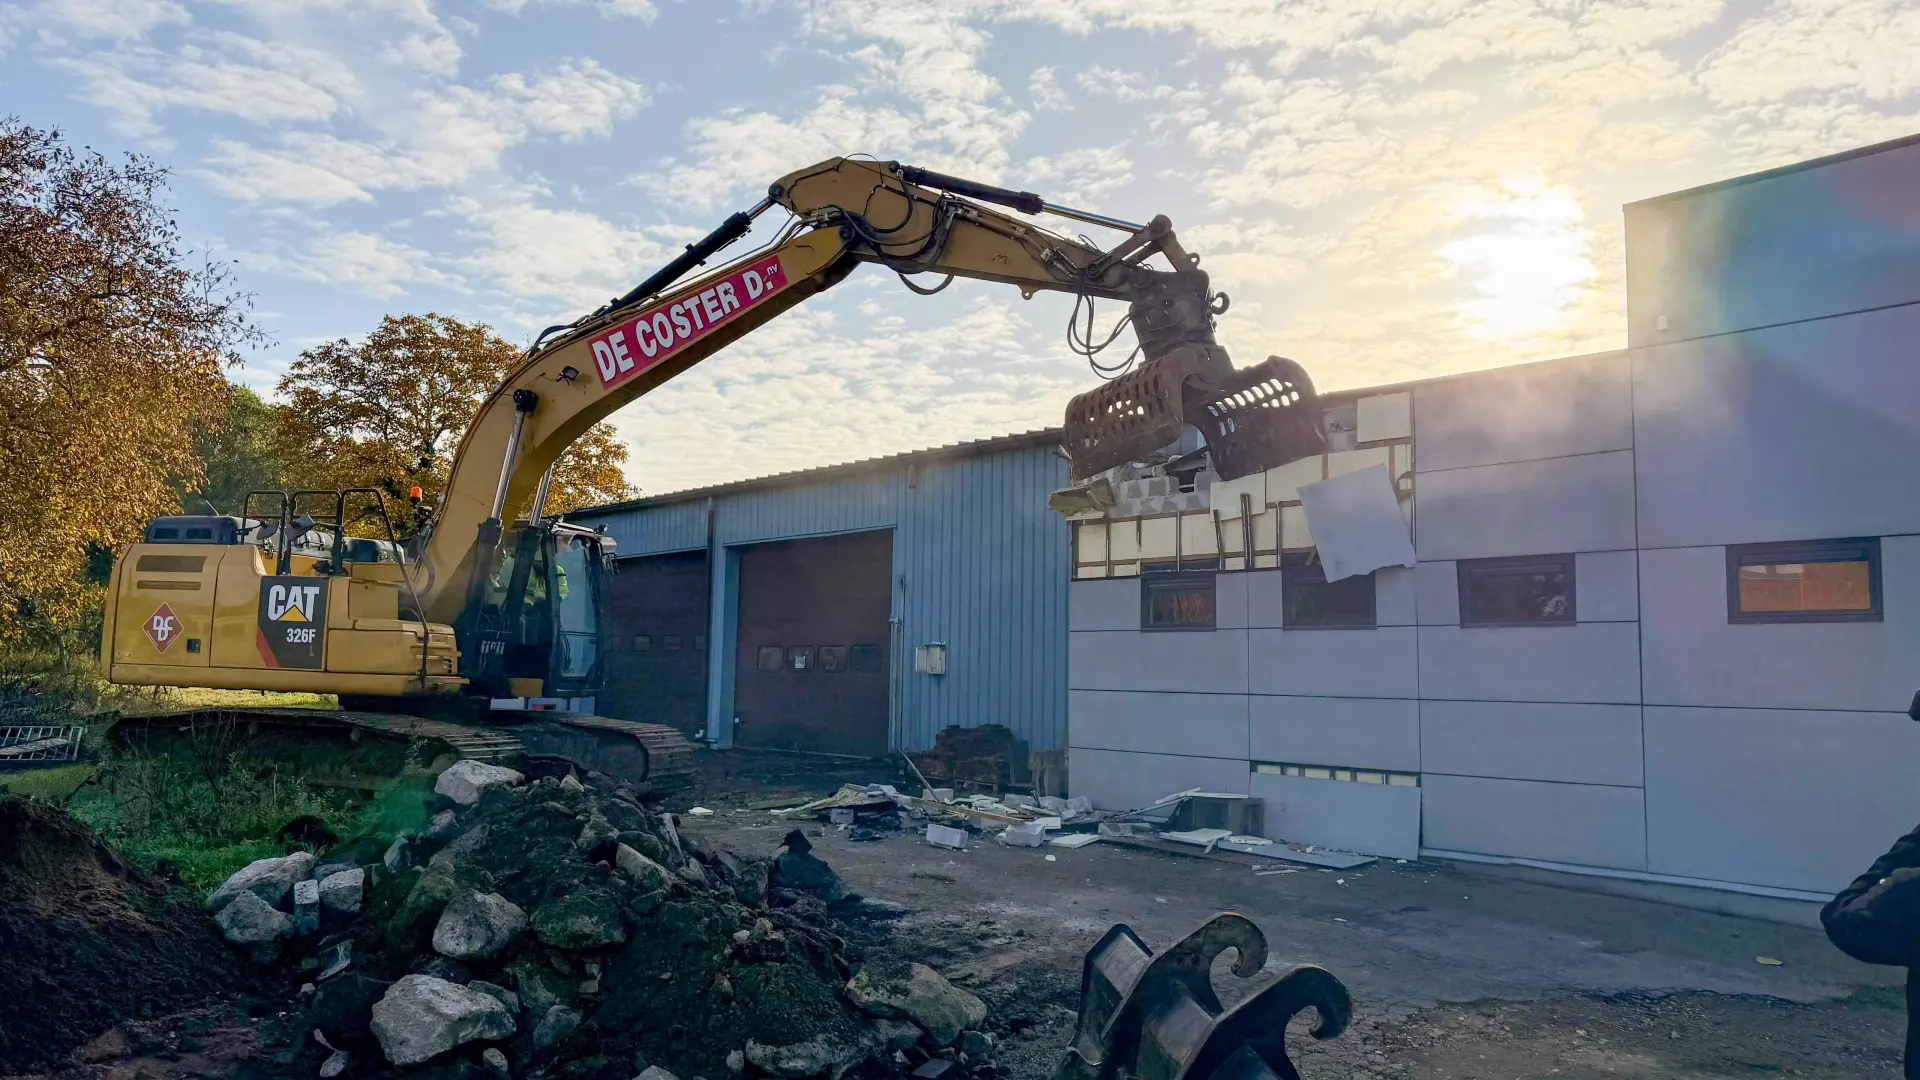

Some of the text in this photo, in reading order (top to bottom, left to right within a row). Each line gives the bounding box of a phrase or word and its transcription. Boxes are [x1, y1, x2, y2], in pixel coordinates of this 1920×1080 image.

[592, 331, 635, 382] DE
[636, 282, 741, 357] COSTER
[268, 585, 320, 622] CAT
[286, 628, 316, 643] 326F
